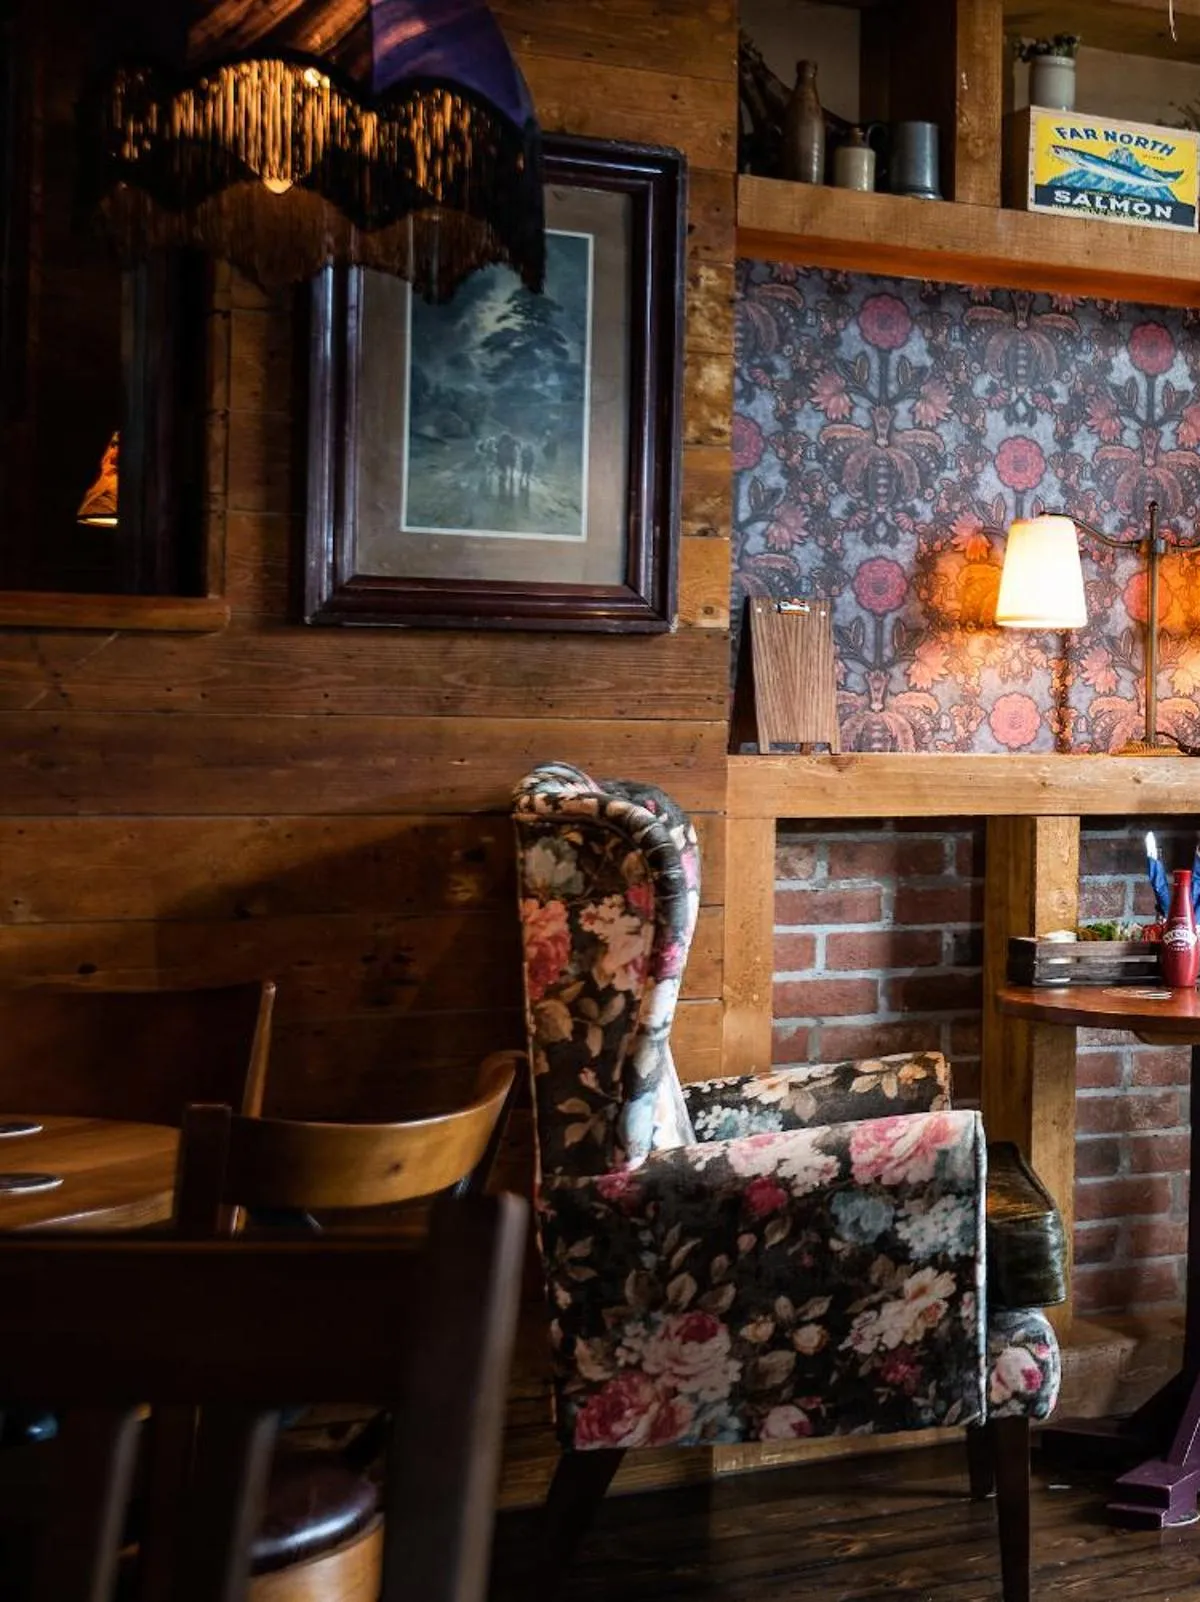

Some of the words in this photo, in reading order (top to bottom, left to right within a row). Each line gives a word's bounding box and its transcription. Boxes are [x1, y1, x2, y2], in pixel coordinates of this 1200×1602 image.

[1055, 127, 1098, 141] FAR
[1103, 130, 1176, 157] NORTH
[1054, 190, 1173, 219] SALMON
